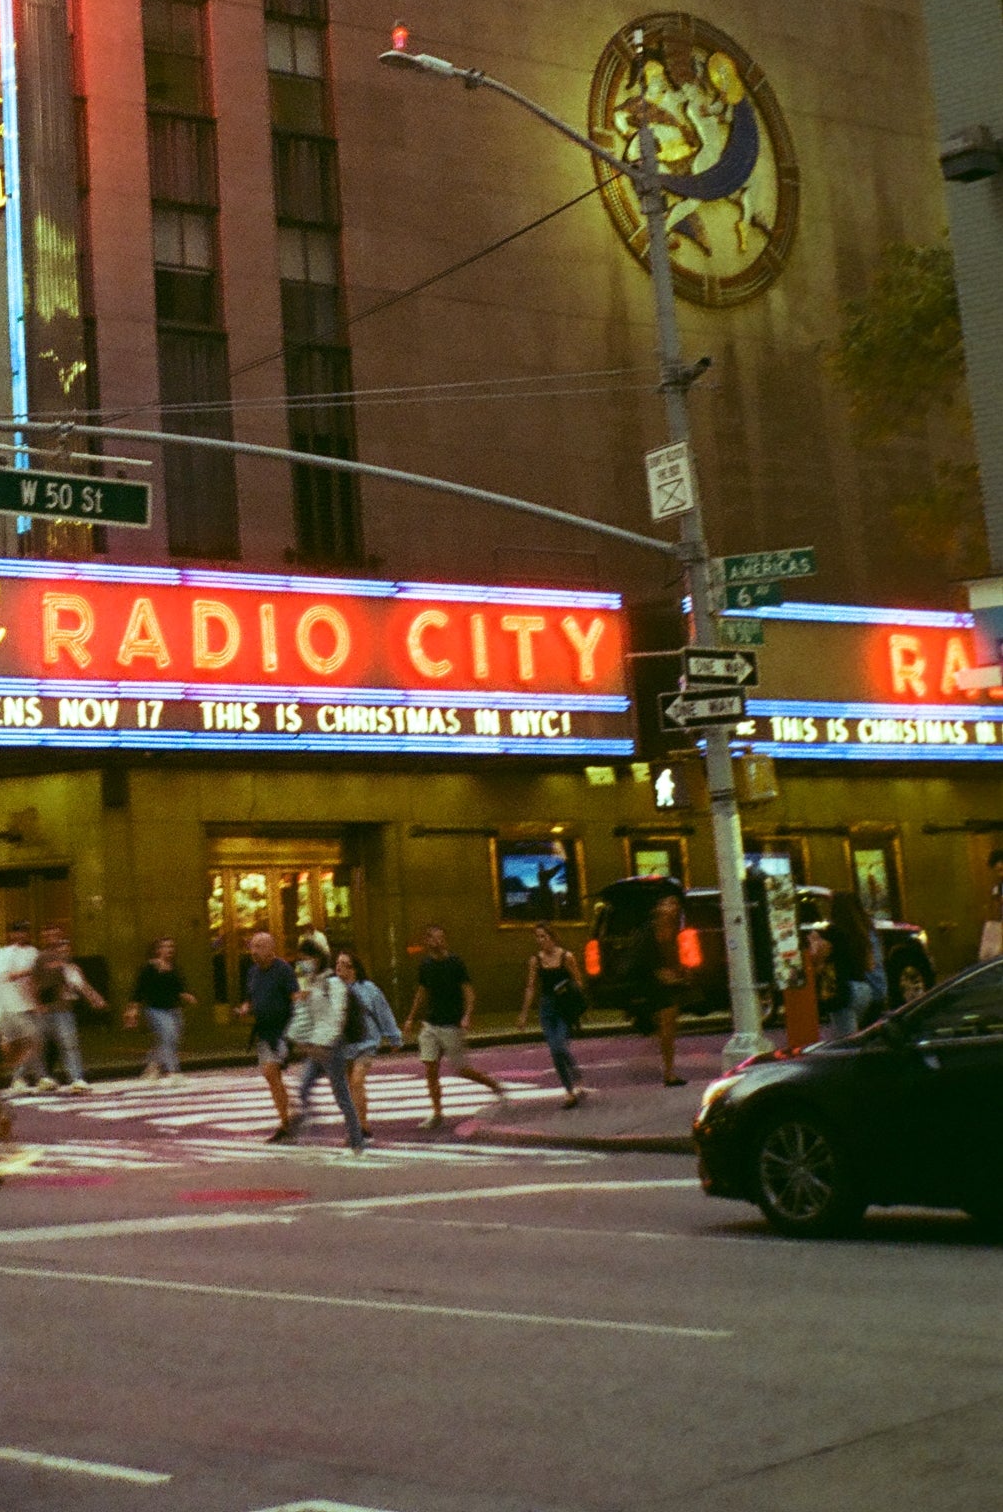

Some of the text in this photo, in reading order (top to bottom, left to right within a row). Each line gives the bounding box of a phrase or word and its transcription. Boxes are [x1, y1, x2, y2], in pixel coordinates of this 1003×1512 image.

[21, 480, 104, 514] W 50 St
[730, 557, 811, 580] AMERICAS
[738, 587, 751, 607] 6
[41, 591, 605, 682] RADIO CITY
[59, 698, 120, 728] NOV
[137, 700, 163, 730] 17
[200, 701, 261, 732] THIS
[276, 702, 302, 732] IS
[317, 704, 462, 735] CHRISTMAS
[475, 706, 500, 736] IN
[511, 708, 571, 737] NYC!
[709, 698, 734, 714] WAY
[770, 716, 818, 742] THIS
[827, 717, 848, 742] IS
[857, 716, 968, 744] CHRISTMAS
